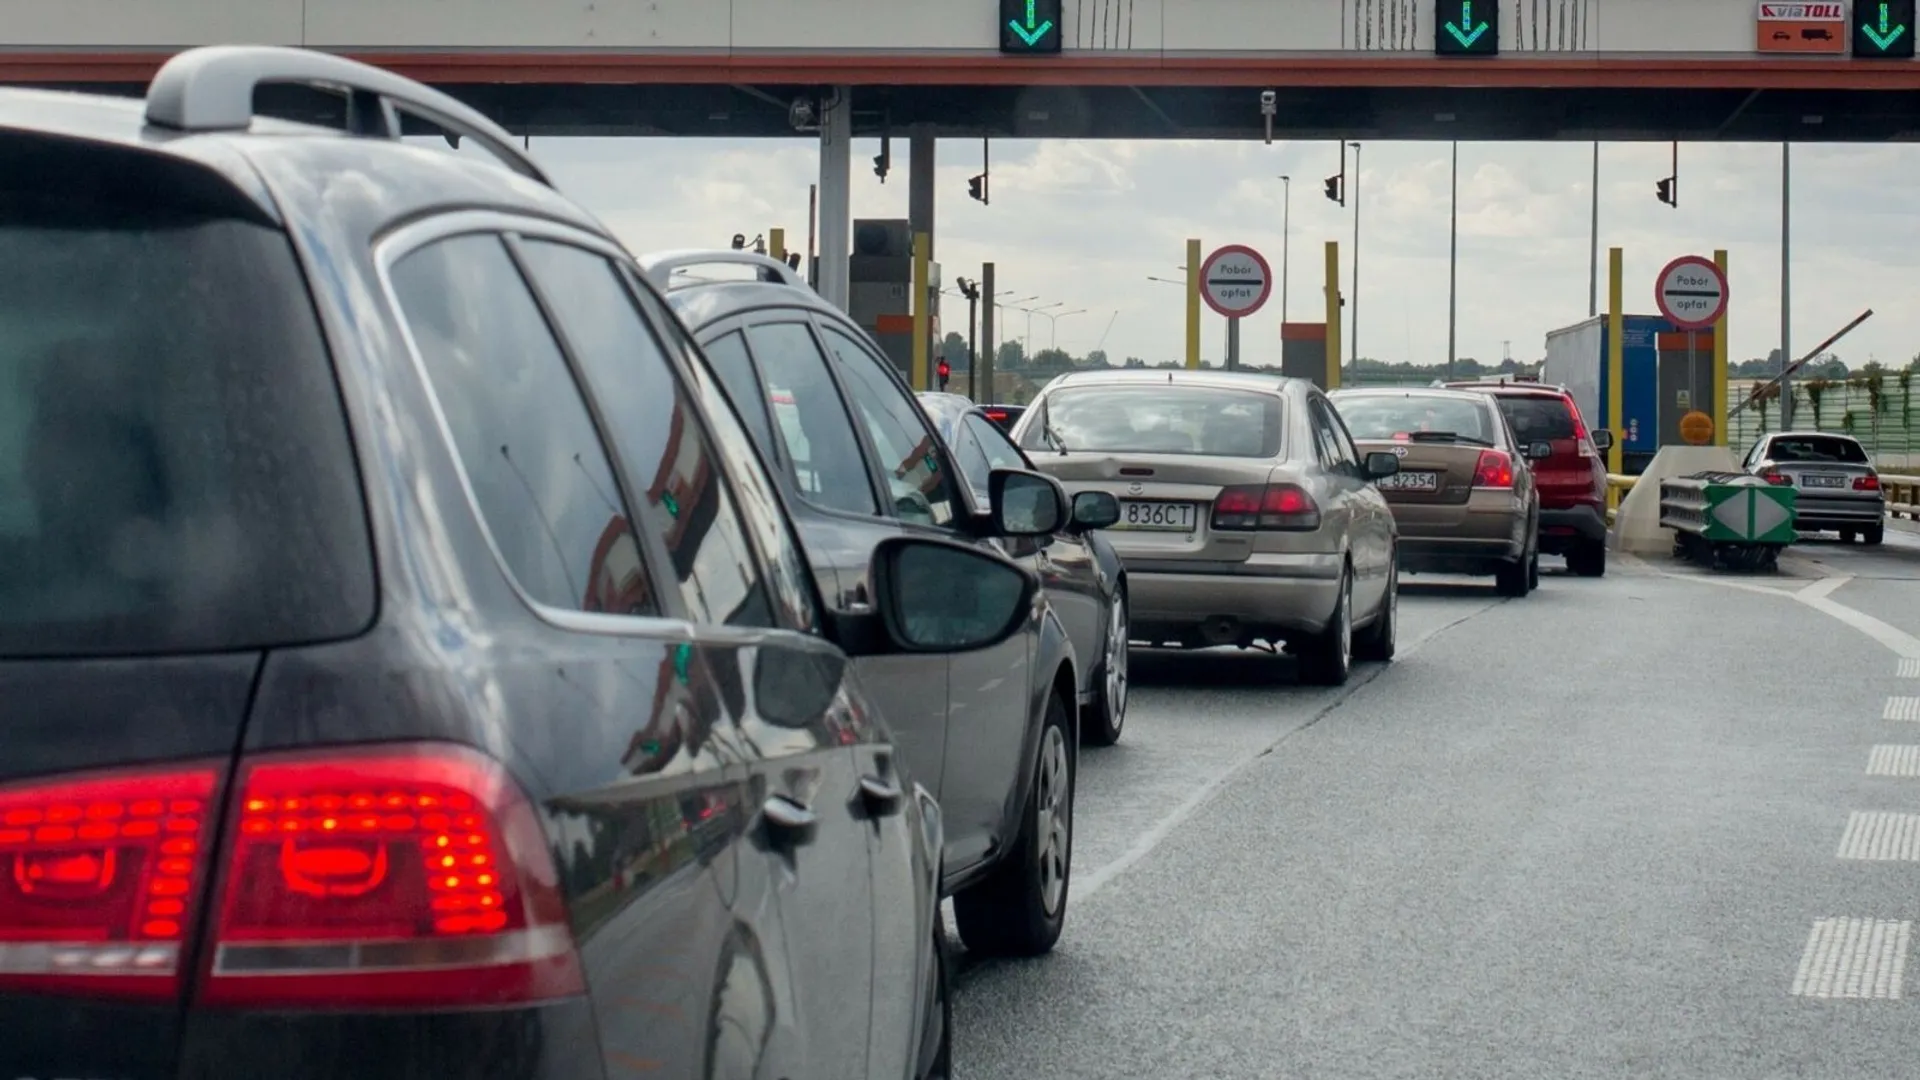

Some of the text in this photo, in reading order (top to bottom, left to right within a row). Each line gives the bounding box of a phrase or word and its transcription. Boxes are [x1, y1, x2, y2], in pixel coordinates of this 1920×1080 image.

[1777, 4, 1841, 17] viaTOLL
[1393, 474, 1435, 488] 82354
[1127, 503, 1191, 525] 836CT
